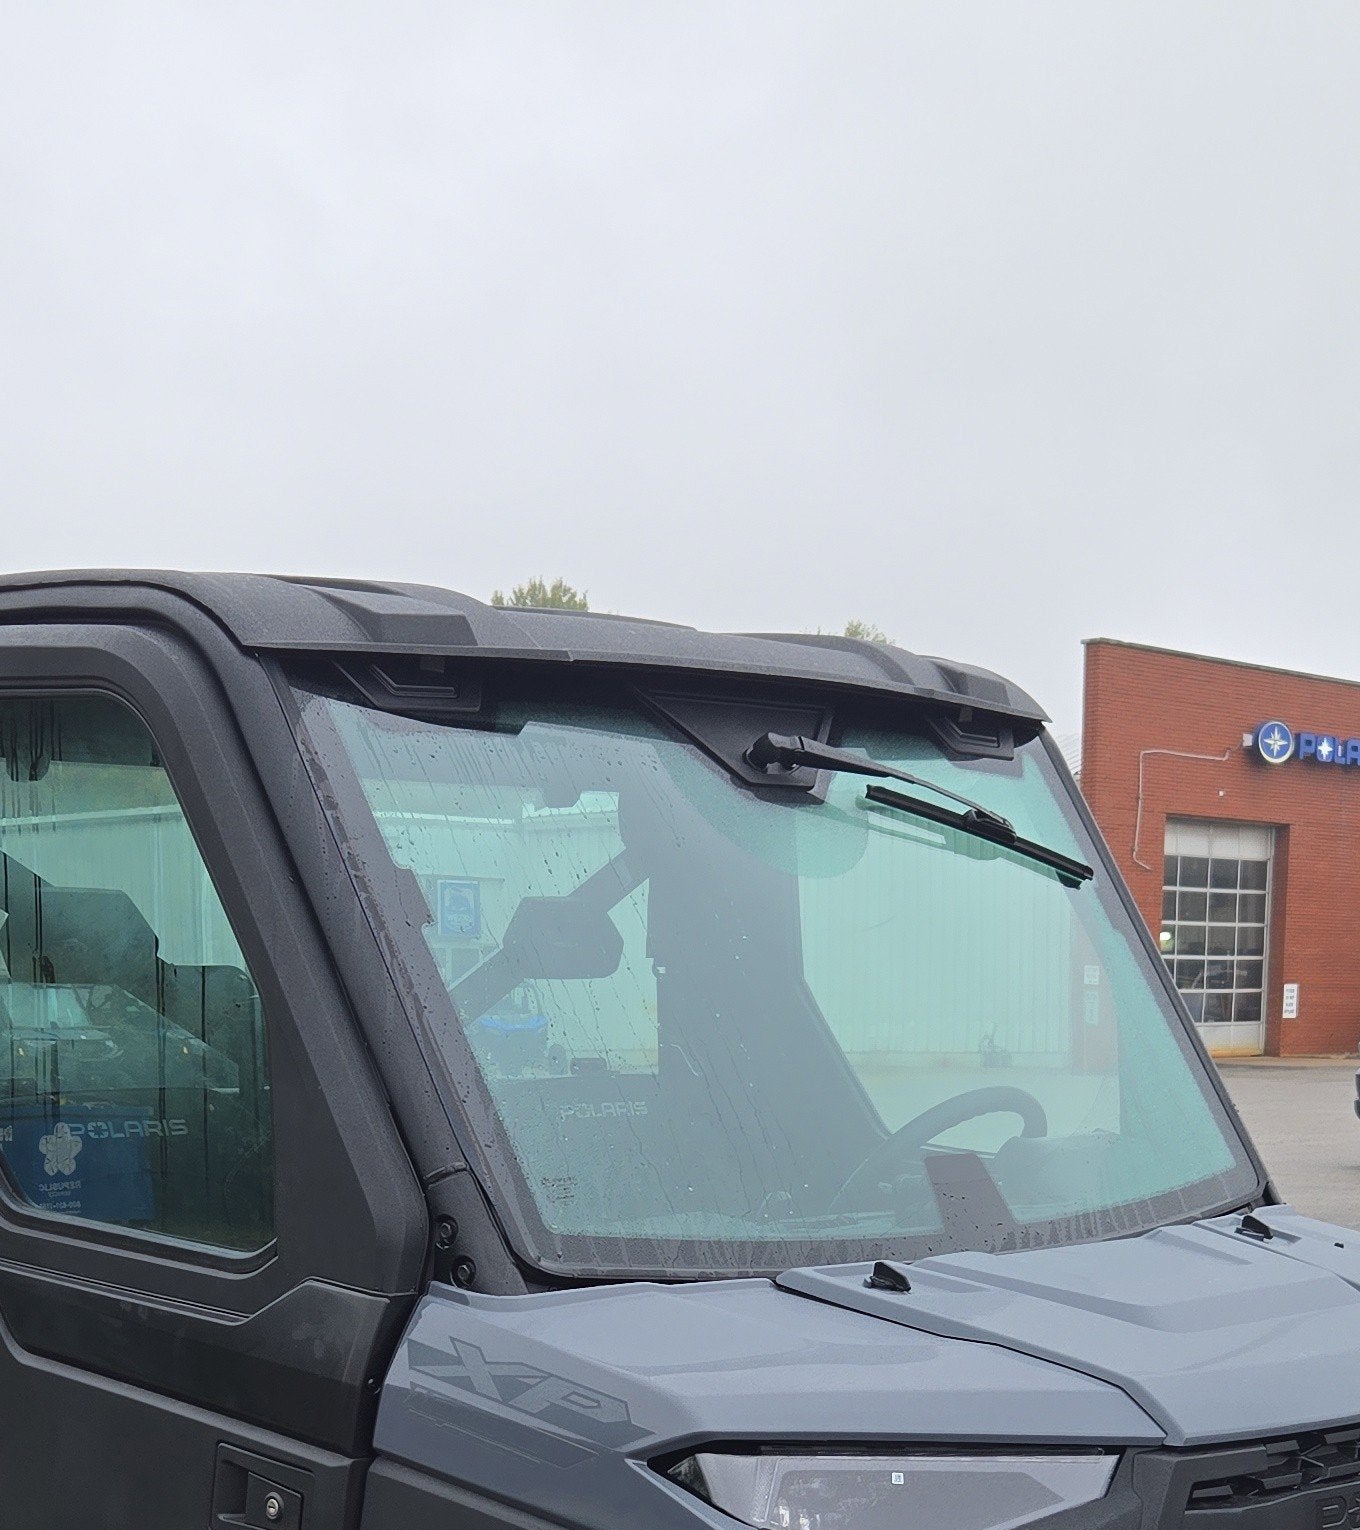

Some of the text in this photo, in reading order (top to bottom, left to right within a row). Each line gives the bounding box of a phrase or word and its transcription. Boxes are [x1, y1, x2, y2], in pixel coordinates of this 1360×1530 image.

[560, 1101, 648, 1121] POLARIS
[66, 1119, 189, 1139] POLARIS
[408, 1336, 634, 1428] XP
